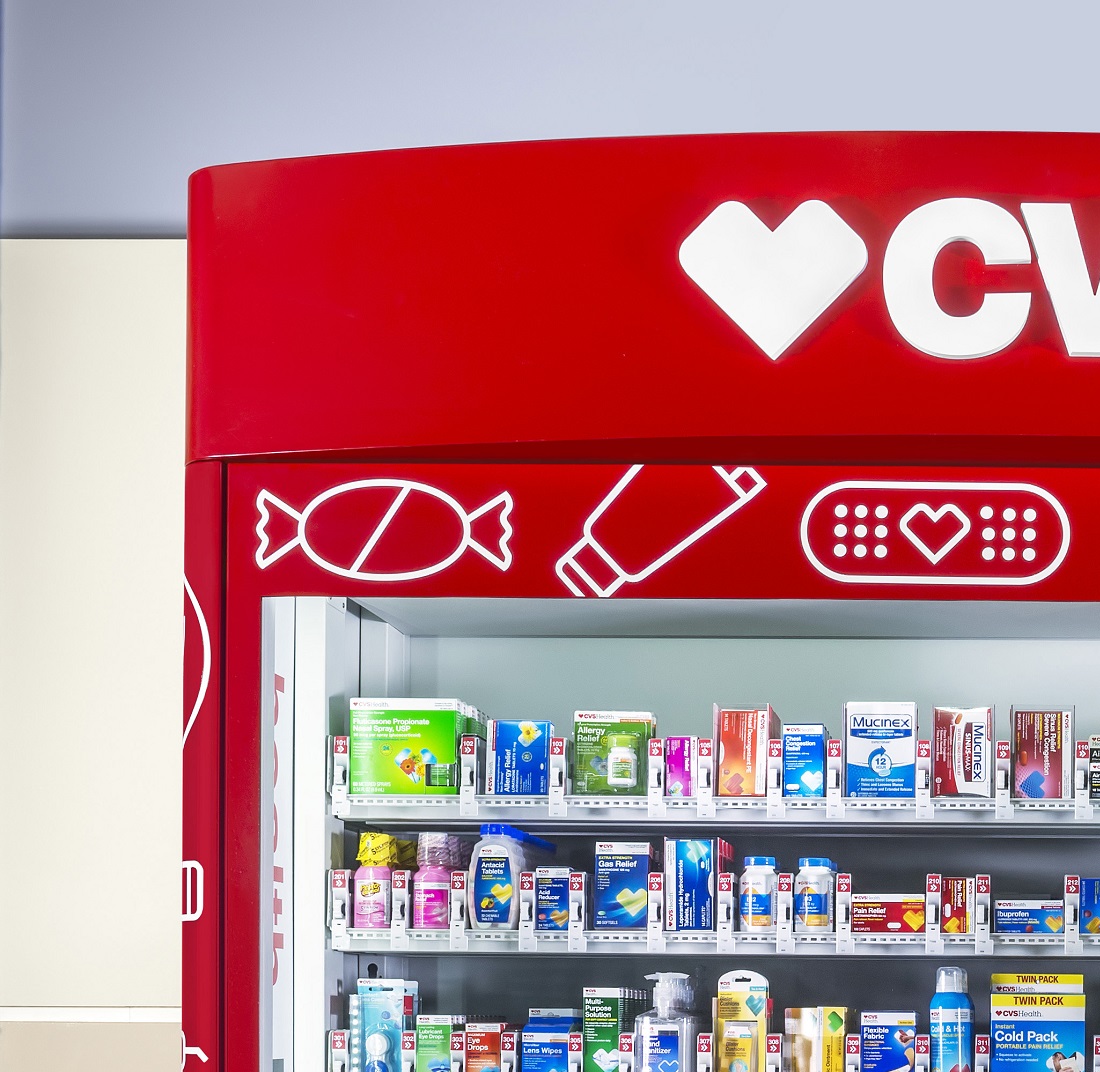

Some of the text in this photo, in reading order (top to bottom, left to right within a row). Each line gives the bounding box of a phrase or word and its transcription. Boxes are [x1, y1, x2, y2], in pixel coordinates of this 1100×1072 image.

[853, 716, 909, 728] Mucinex
[577, 727, 606, 736] Allergy
[973, 725, 984, 780] Mucinex
[1014, 997, 1063, 1005] TWIN PACK
[468, 1036, 480, 1045] Eye
[995, 1031, 1058, 1042] Cold Pack
